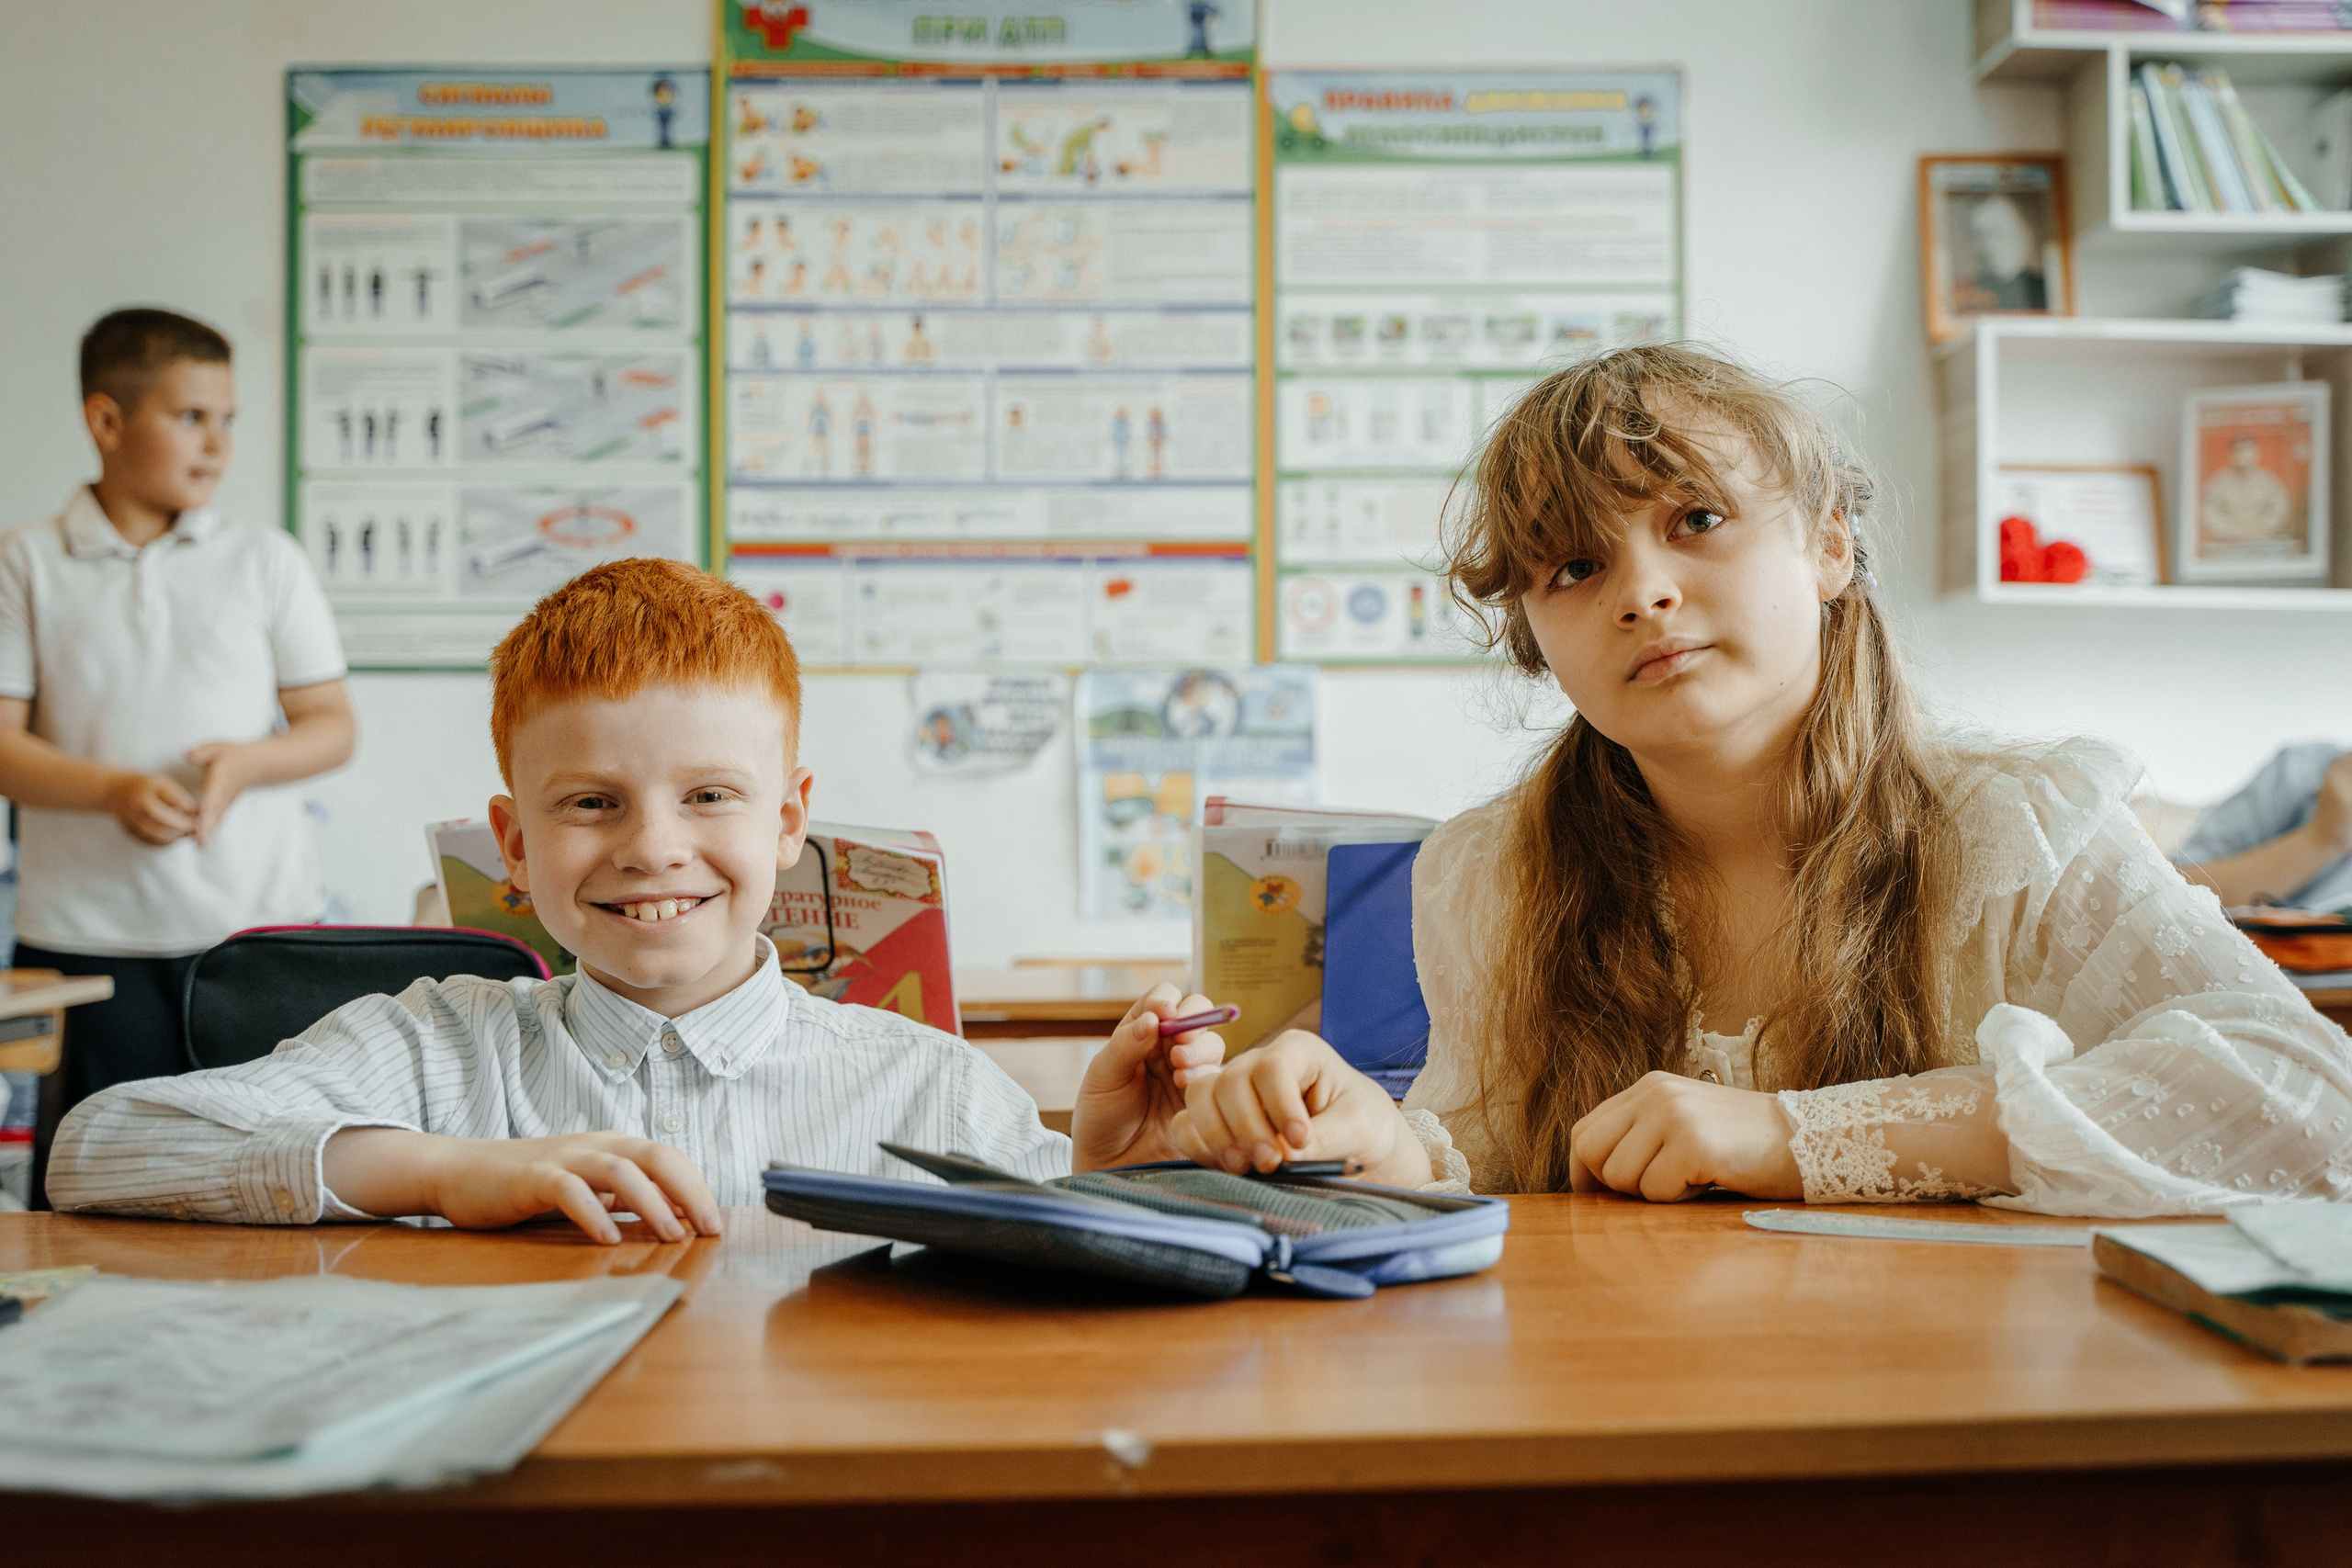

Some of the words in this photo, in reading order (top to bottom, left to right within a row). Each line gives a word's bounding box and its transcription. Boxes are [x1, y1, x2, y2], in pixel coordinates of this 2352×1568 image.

[912, 16, 987, 45] ПРИ
[999, 16, 1066, 46] ДТП
[773, 890, 881, 911] ературное
[763, 906, 861, 930] ТЕНИЕ
